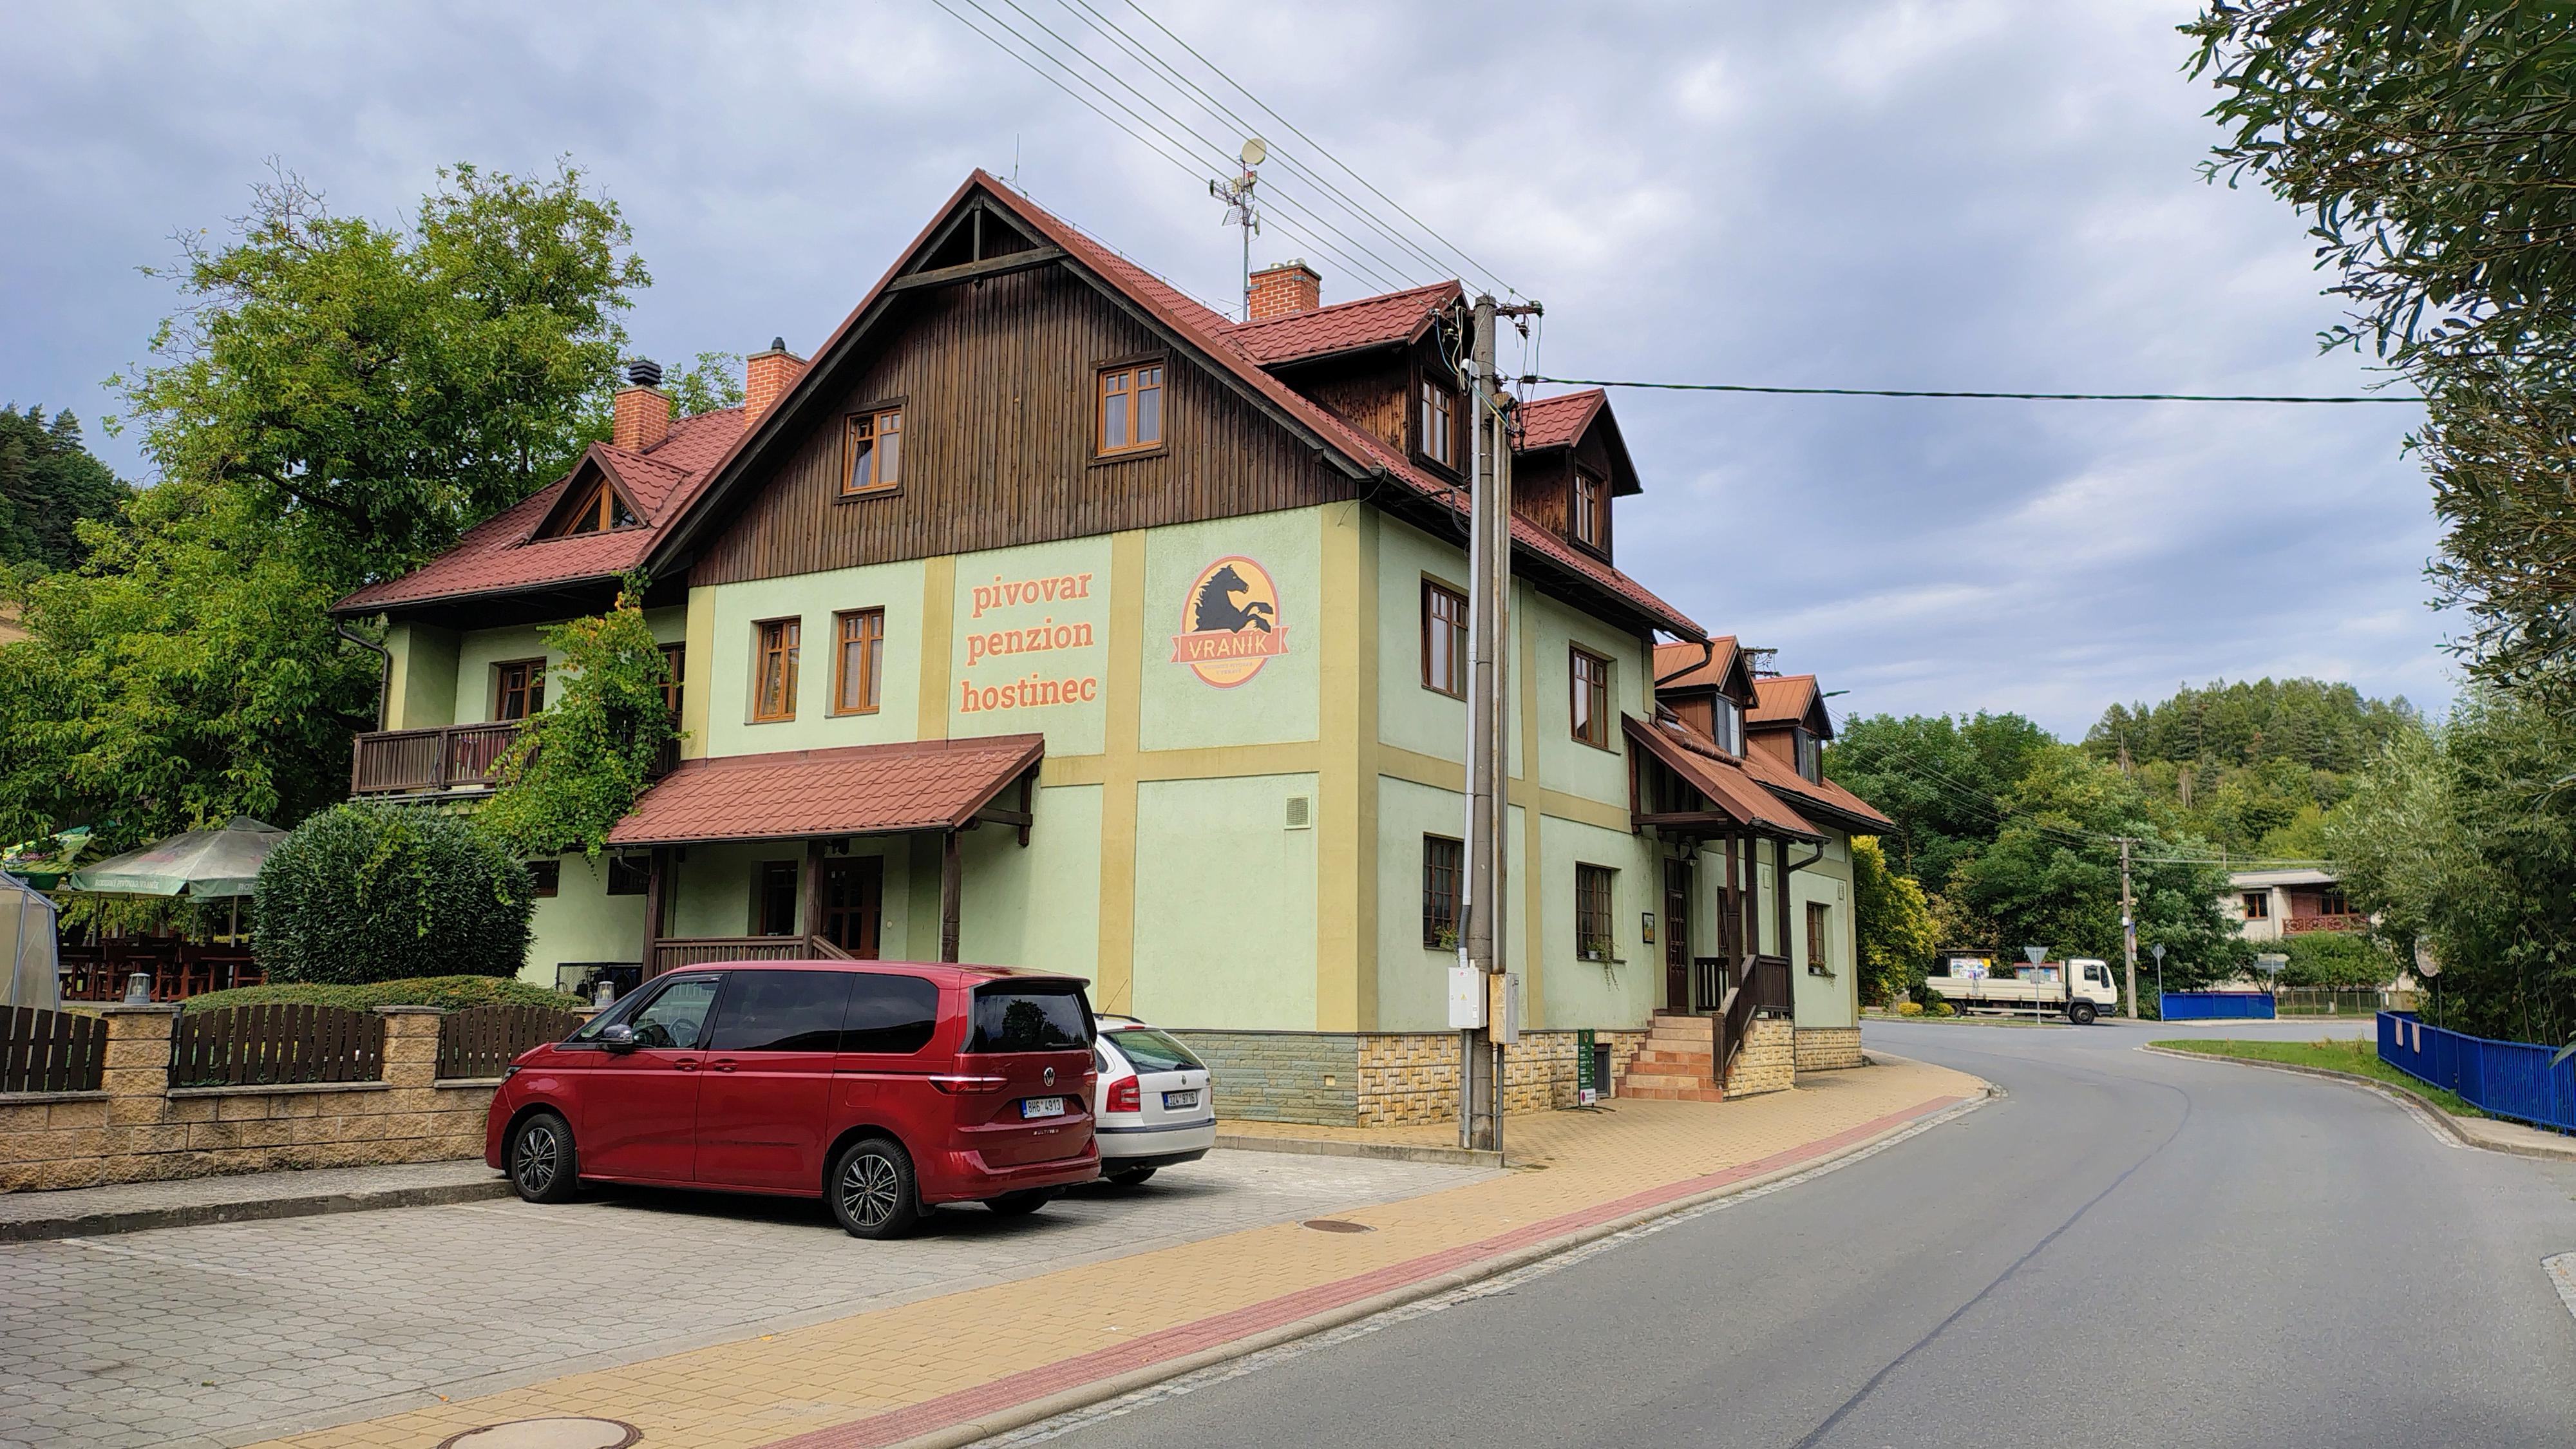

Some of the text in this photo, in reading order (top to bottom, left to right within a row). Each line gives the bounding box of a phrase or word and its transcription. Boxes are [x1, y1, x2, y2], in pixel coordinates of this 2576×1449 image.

[972, 573, 1092, 618] pivovar
[967, 618, 1094, 666] penzion
[1188, 632, 1268, 659] VRANÍK
[960, 674, 1097, 713] hostinec
[1028, 1099, 1061, 1113] 8H6 4913
[1169, 1092, 1195, 1106] 3Z4 9716
